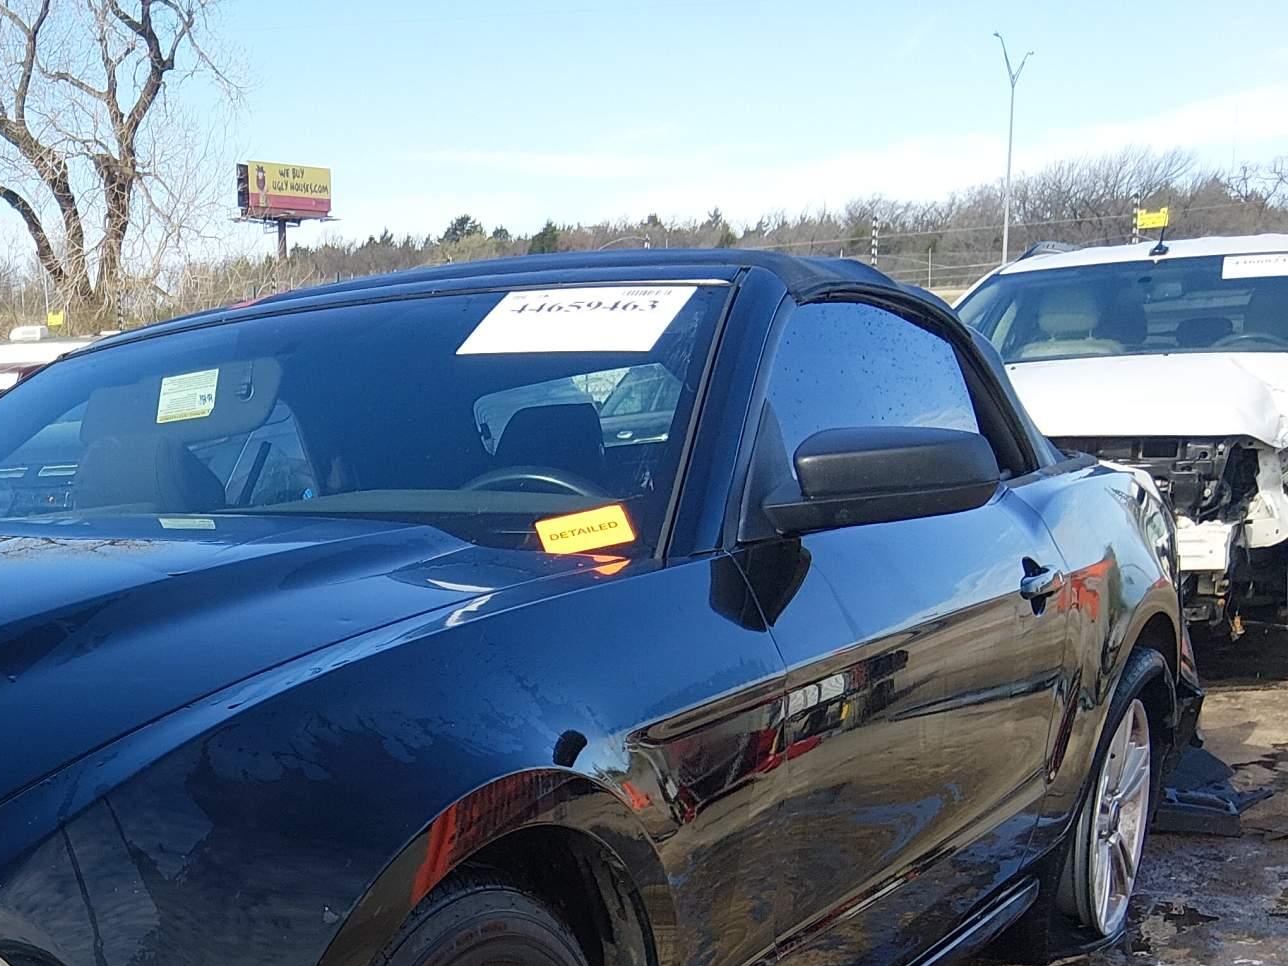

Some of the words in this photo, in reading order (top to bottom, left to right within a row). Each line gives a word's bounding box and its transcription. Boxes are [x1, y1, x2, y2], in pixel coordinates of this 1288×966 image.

[279, 168, 290, 178] WE
[292, 168, 305, 179] BUY
[272, 180, 288, 192] UGLY
[511, 299, 660, 314] 44659463
[549, 521, 618, 541] DETAILED
